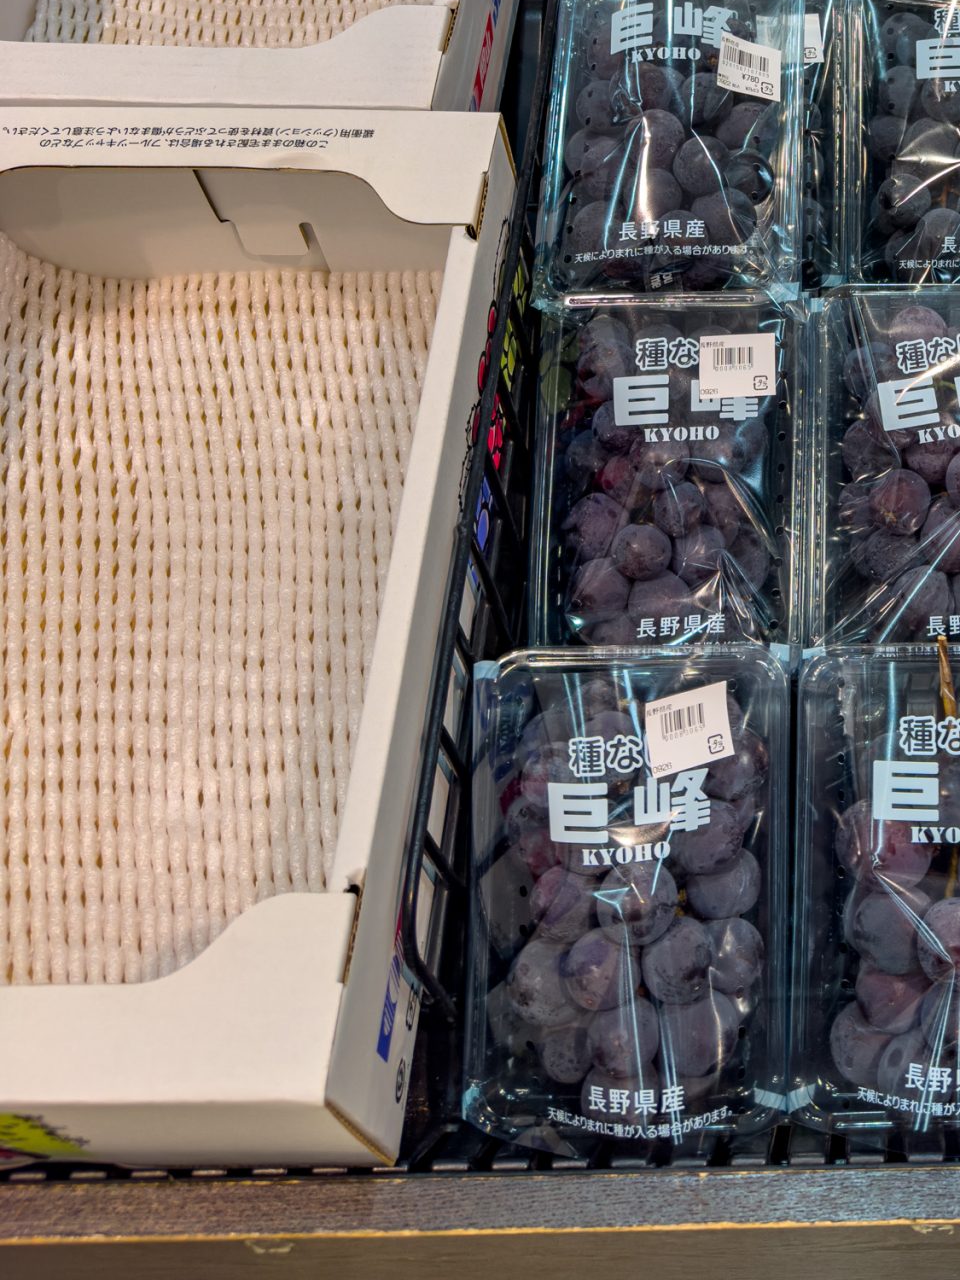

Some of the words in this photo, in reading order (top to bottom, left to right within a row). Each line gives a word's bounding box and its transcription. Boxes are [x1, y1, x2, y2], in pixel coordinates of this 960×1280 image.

[611, 2, 738, 54] 巨峰
[631, 47, 701, 63] KYOHO
[618, 219, 706, 241] 長野県産
[635, 337, 700, 370] 種な
[644, 425, 720, 443] KYOHO
[636, 612, 727, 638] 長野県産
[568, 734, 652, 778] 種な
[548, 768, 711, 844] 巨峰
[582, 840, 671, 866] KYOHO
[588, 1086, 685, 1115] 長野県産
